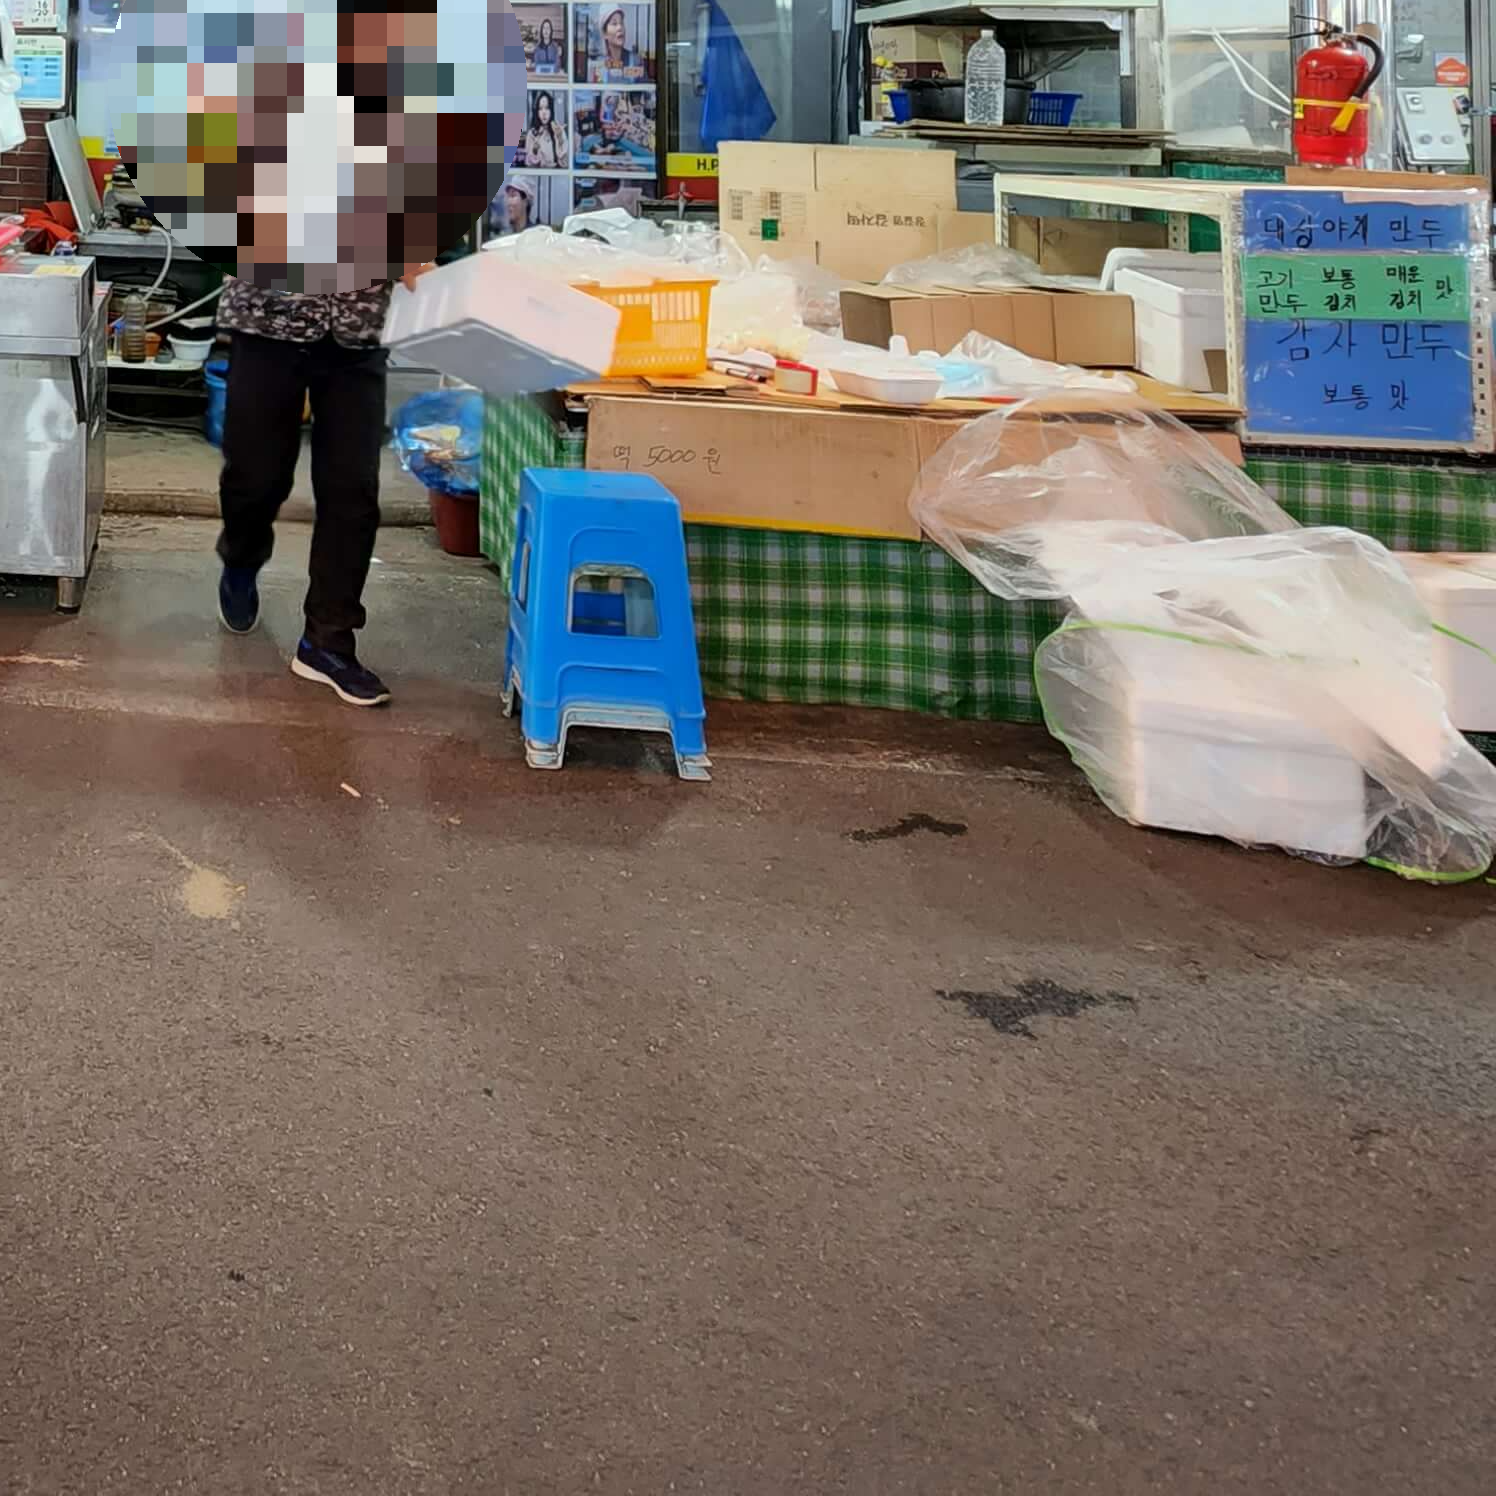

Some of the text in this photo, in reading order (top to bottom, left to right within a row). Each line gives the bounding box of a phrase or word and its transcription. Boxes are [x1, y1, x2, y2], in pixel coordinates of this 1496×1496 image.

[1389, 214, 1445, 248] 만두
[1256, 265, 1454, 300] 고기 보통 매운 맛
[1259, 291, 1306, 313] 만두
[1277, 319, 1452, 361] 감자 만두
[1322, 377, 1411, 410] 보통 맛
[642, 445, 696, 467] 5000
